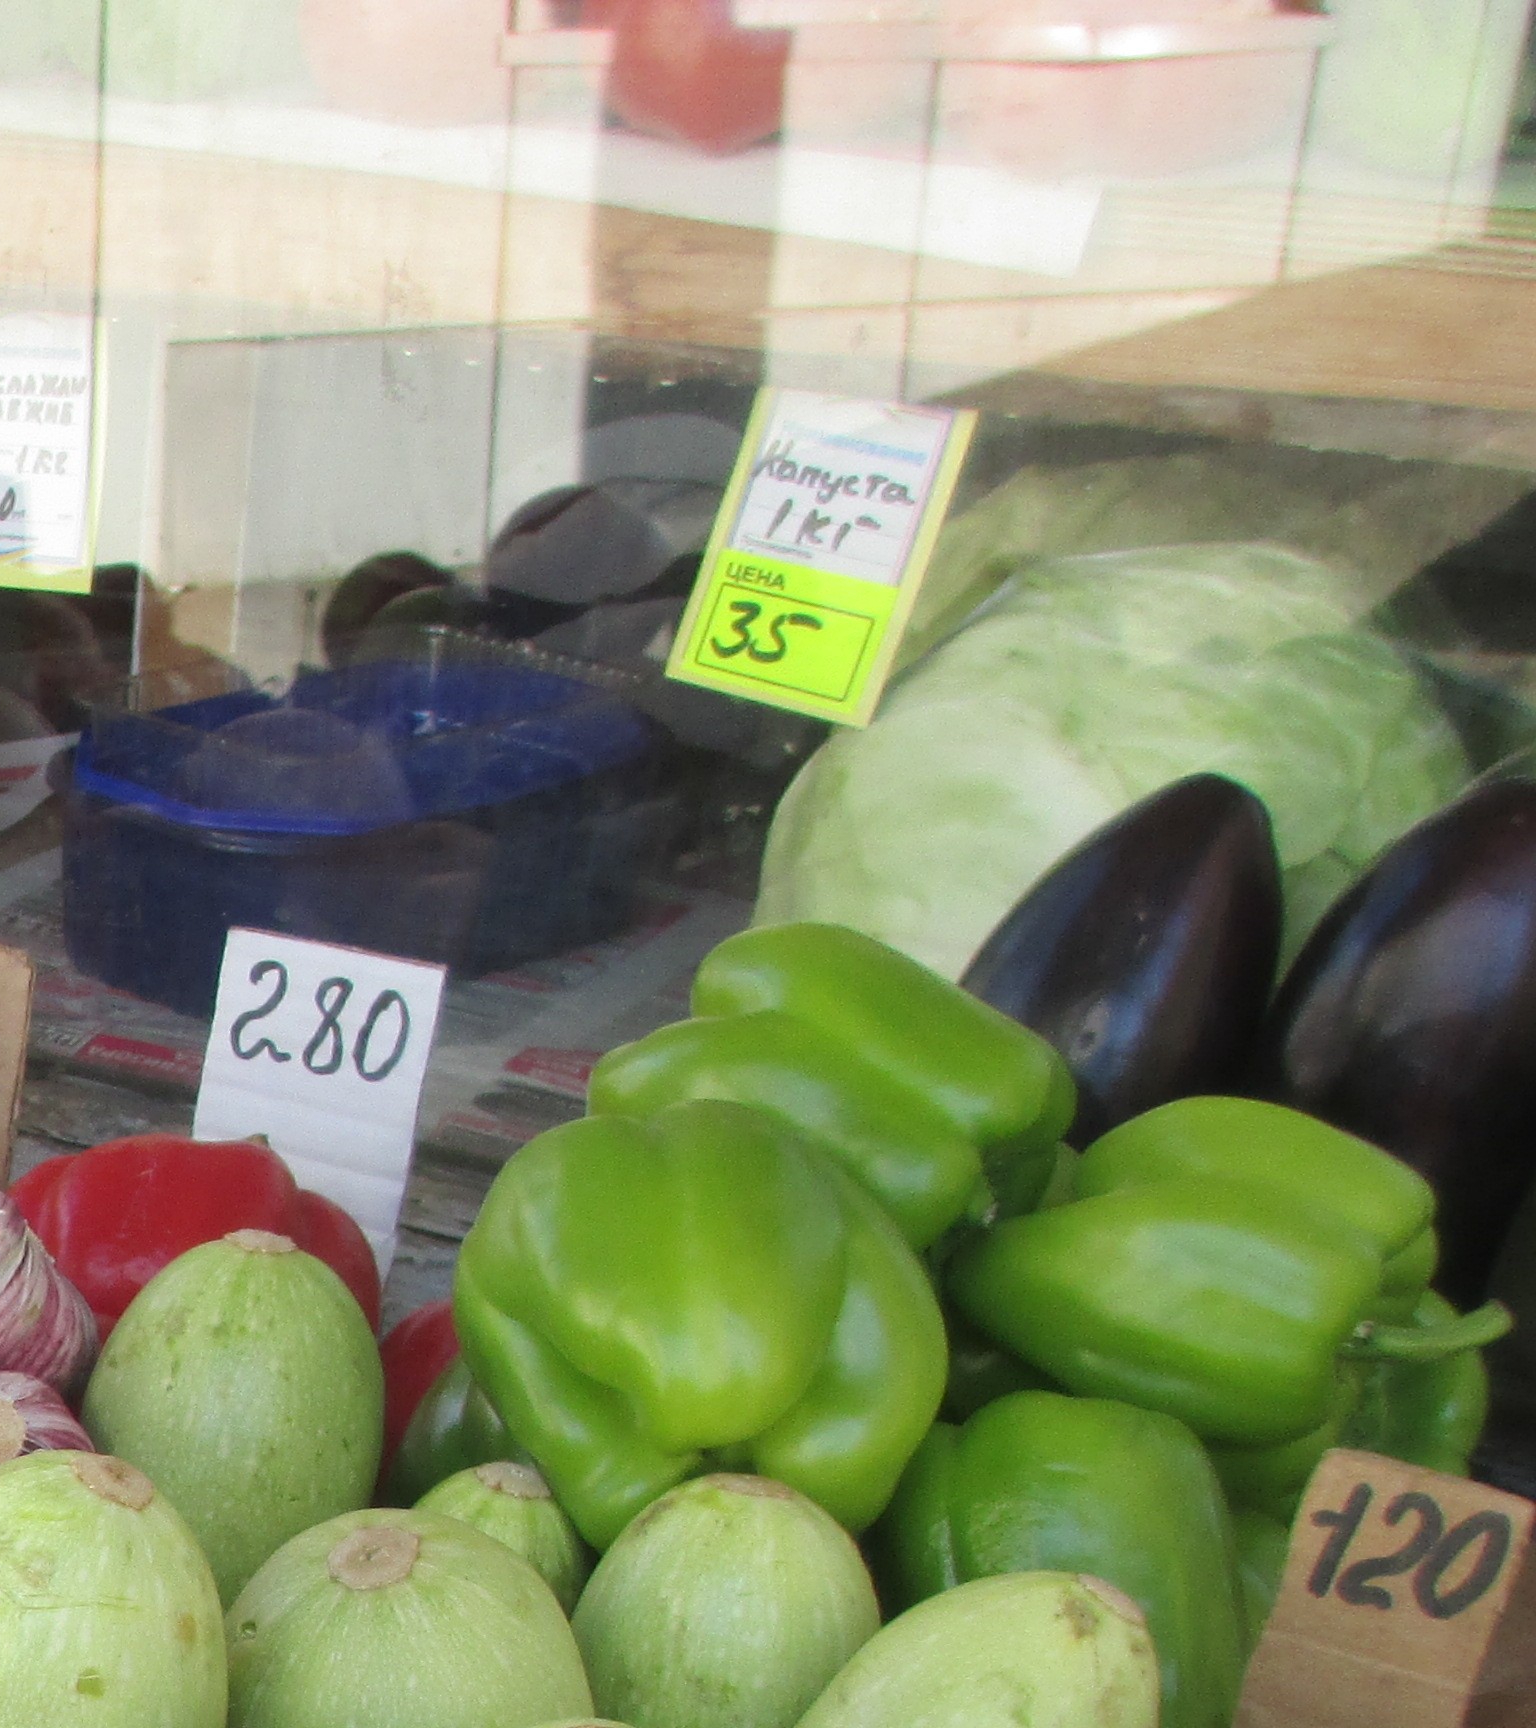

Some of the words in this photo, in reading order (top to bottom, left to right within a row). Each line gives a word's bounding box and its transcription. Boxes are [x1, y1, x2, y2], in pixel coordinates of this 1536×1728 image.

[753, 438, 915, 506] Капуста
[725, 562, 785, 590] ЦЕНА
[710, 600, 823, 663] 35
[230, 959, 411, 1083] 280
[1307, 1482, 1513, 1621] 120
